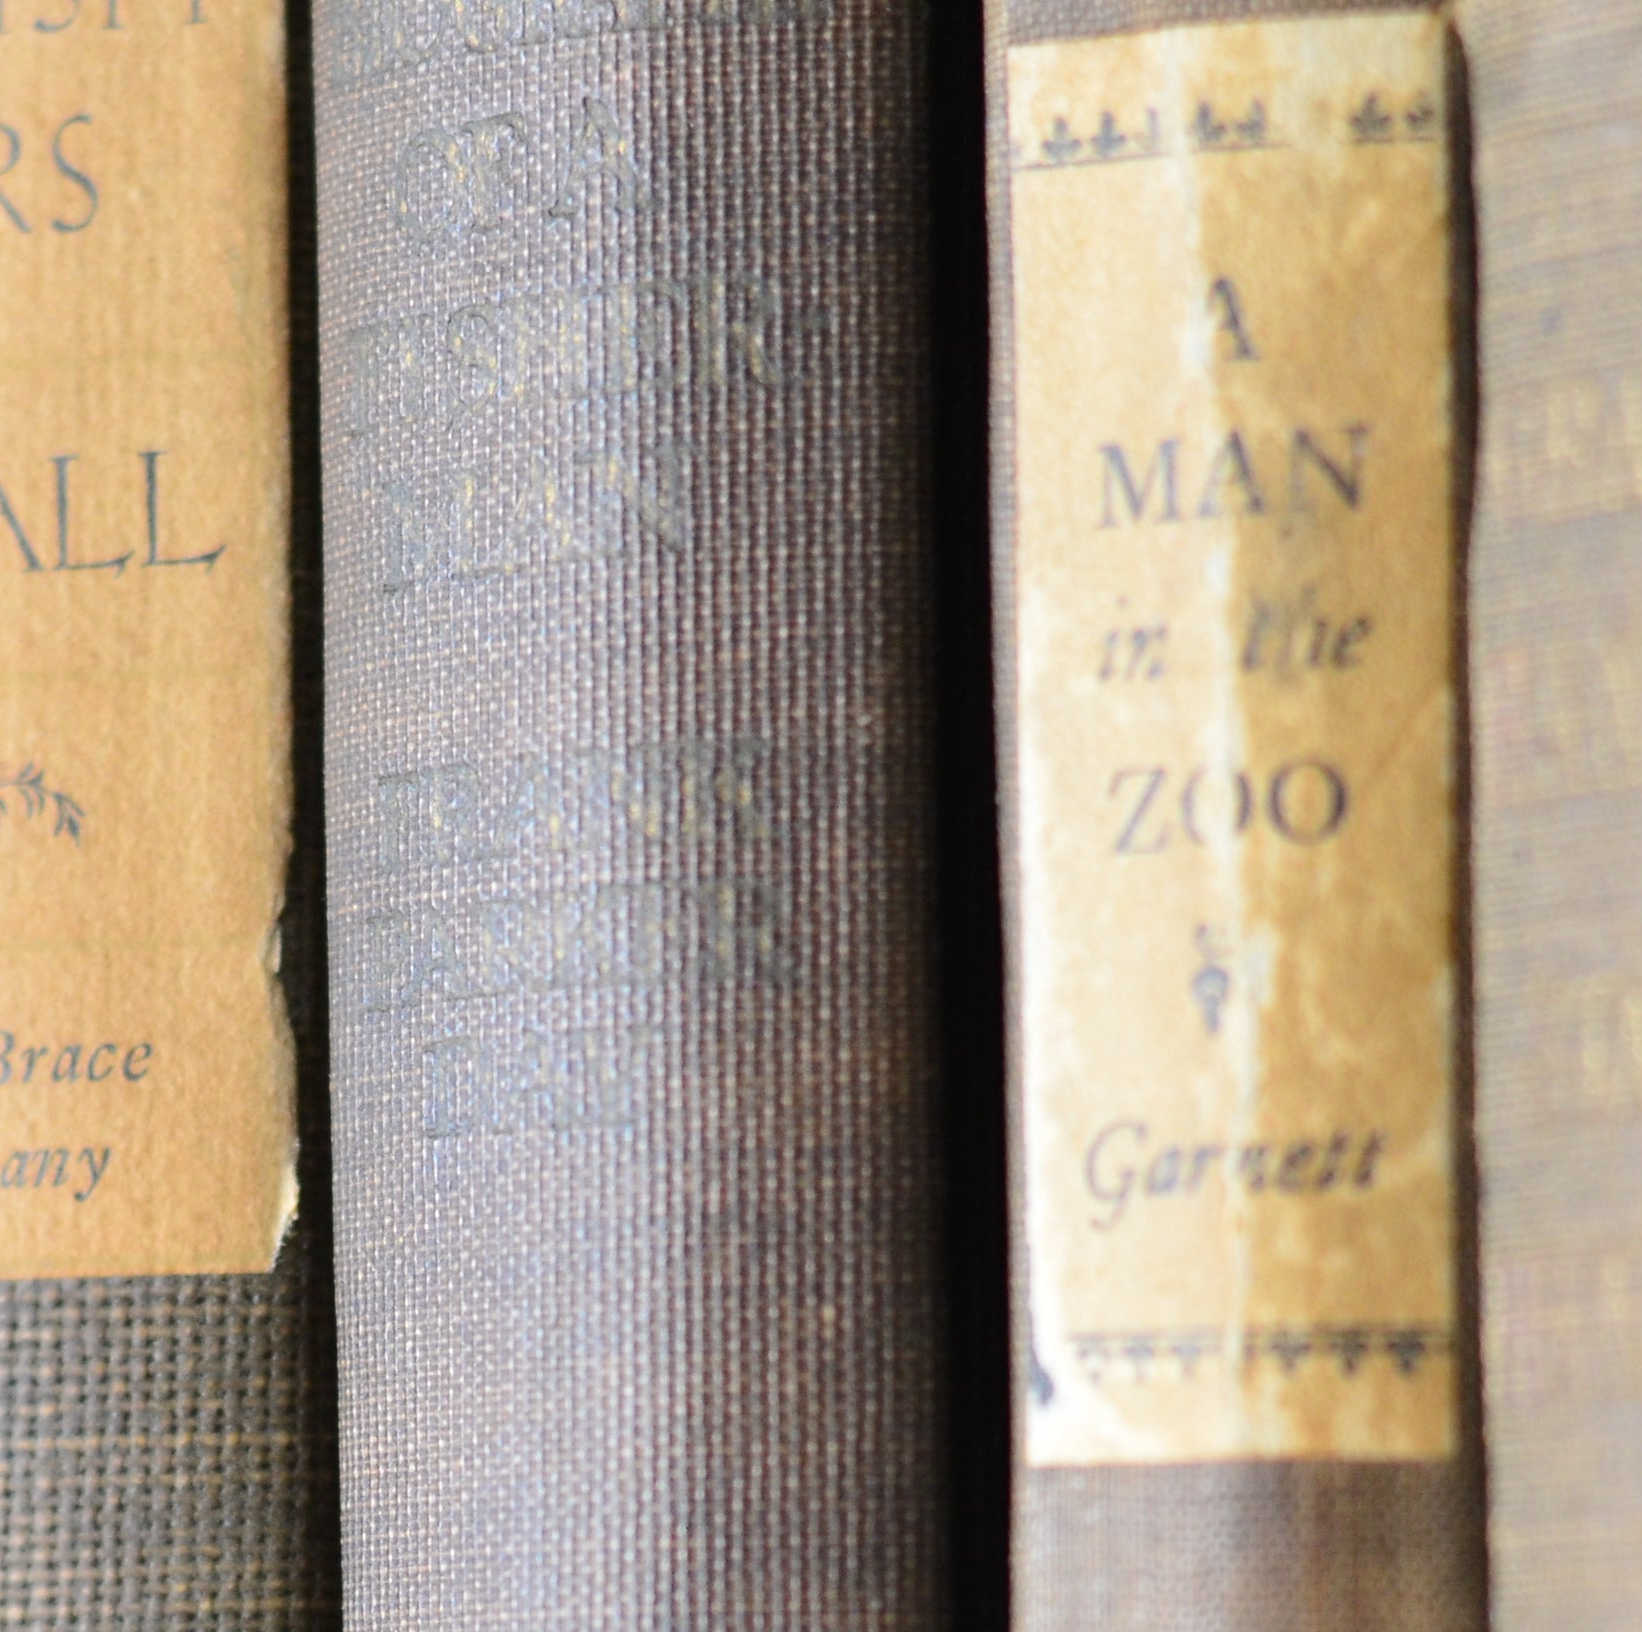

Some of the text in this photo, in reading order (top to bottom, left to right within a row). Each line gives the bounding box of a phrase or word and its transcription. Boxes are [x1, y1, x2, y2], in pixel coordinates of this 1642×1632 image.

[1204, 275, 1260, 363] A
[1098, 420, 1371, 530] MAN
[1096, 597, 1170, 681] in
[1107, 757, 1350, 855] ZOO
[1083, 1120, 1388, 1231] Garnett
